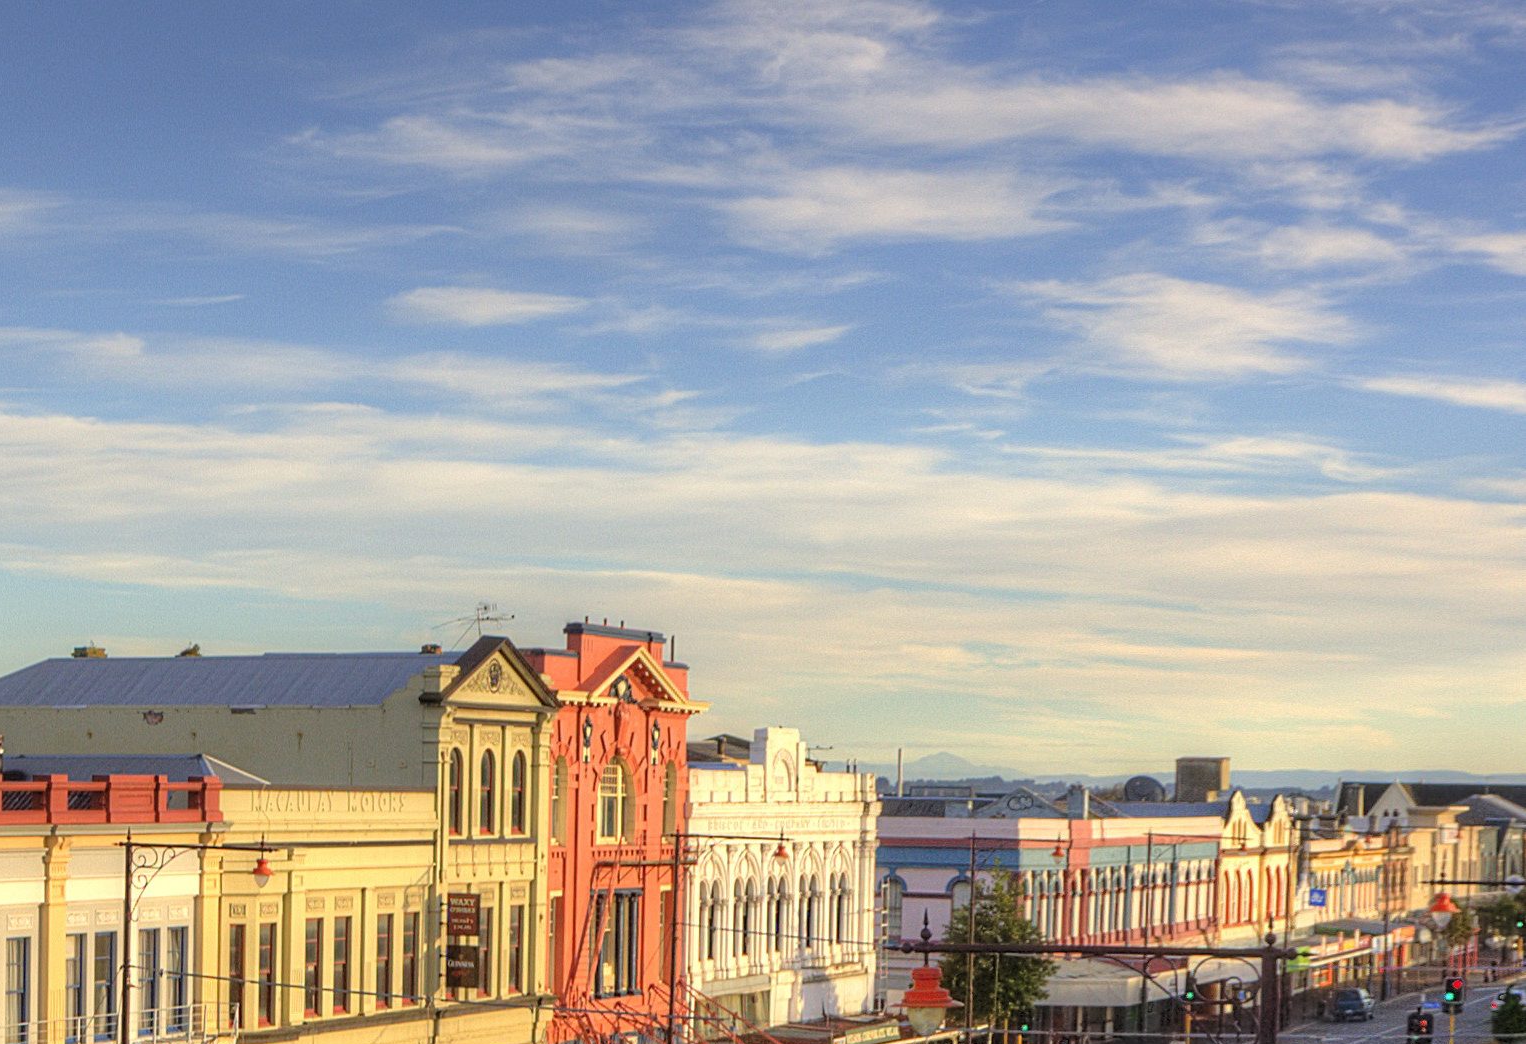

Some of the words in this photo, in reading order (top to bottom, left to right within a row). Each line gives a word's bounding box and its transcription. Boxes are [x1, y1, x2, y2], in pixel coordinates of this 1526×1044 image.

[251, 790, 335, 812] MACAULAY
[346, 791, 406, 812] MOTORS
[450, 898, 475, 906] WAXY
